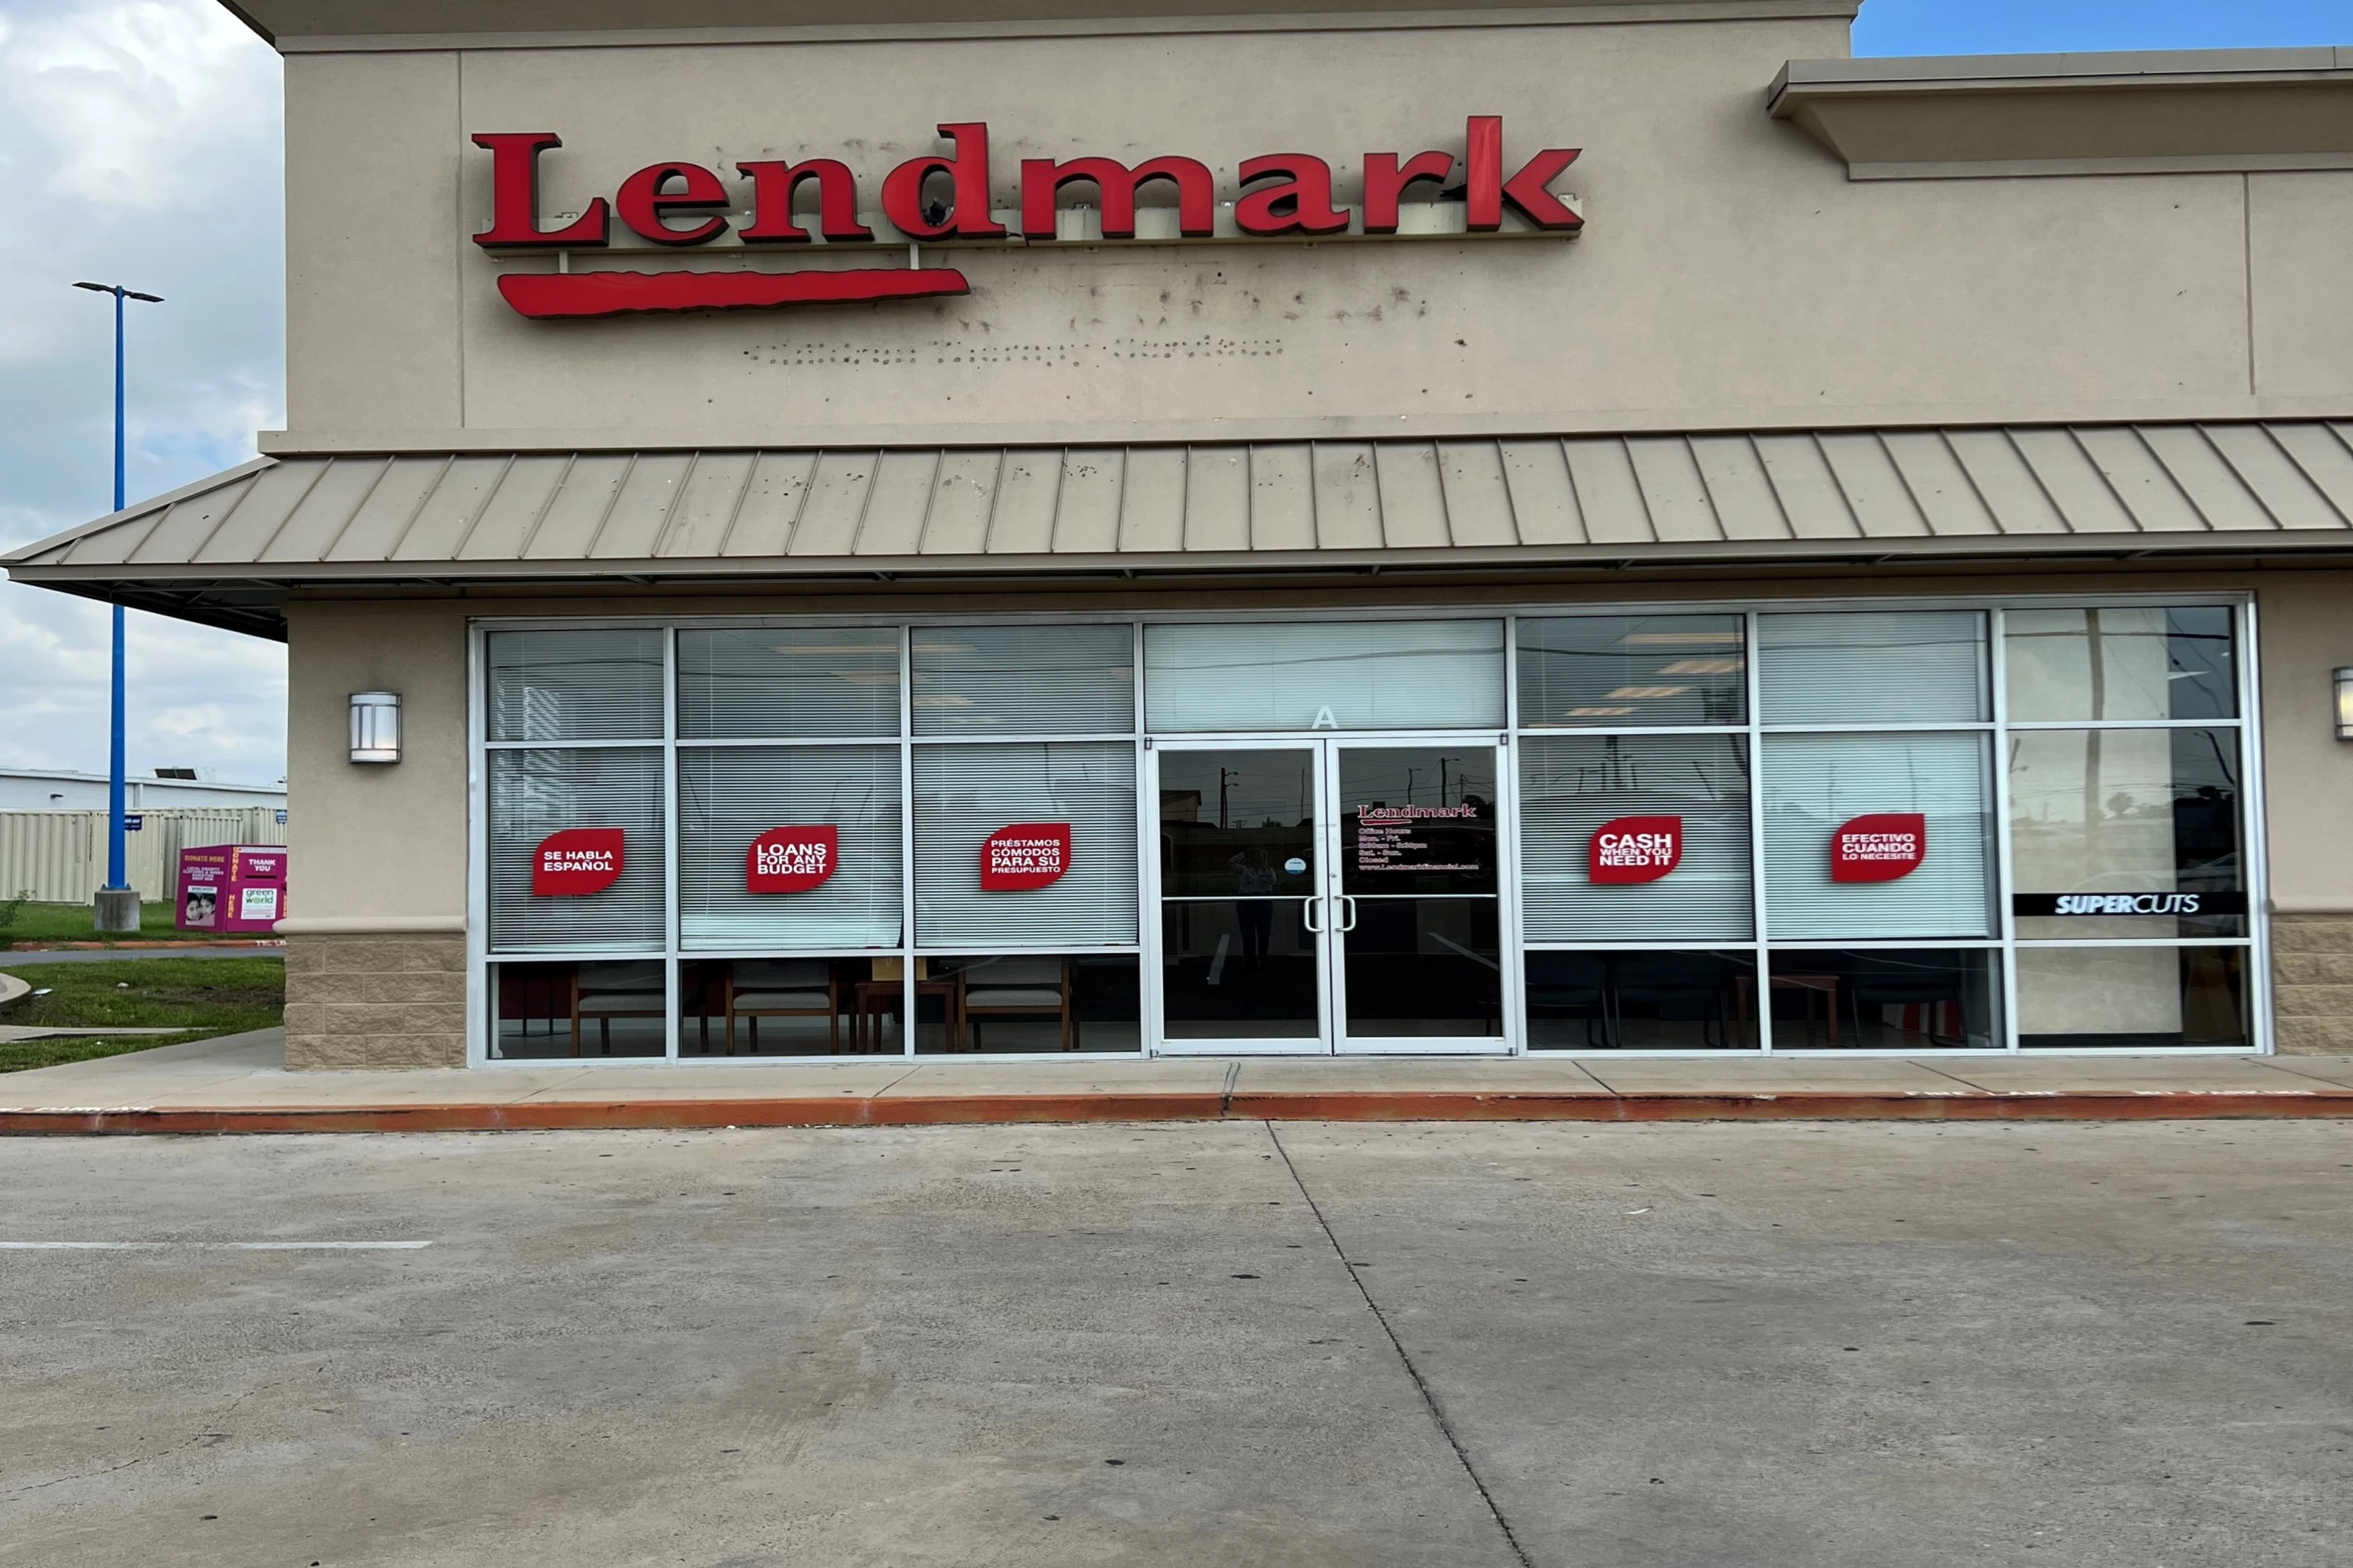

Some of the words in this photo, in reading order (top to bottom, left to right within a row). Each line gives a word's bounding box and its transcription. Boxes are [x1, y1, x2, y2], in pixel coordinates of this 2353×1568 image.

[471, 115, 1585, 248] Lendmark
[1311, 705, 1338, 729] A
[1357, 804, 1477, 818] Lendmark
[991, 838, 1061, 847] PRÉSTAMOS
[1599, 833, 1672, 849] CASH
[1842, 833, 1916, 843] EFECTIVO
[757, 843, 827, 855] LOANS
[991, 847, 1060, 857] CÓMODOS
[1842, 843, 1917, 853] CUANDO
[544, 851, 562, 860] SE
[566, 850, 613, 860] HABLA
[757, 855, 789, 865] FOR
[794, 855, 827, 864] ANY
[544, 860, 613, 871] ESPAÑOL
[991, 857, 1034, 866] PARA
[1038, 857, 1060, 866] SU
[1599, 855, 1650, 866] NEED
[1654, 855, 1672, 866] IT
[757, 864, 827, 874] BUDGET
[2055, 894, 2200, 914] SUPERCUTS
